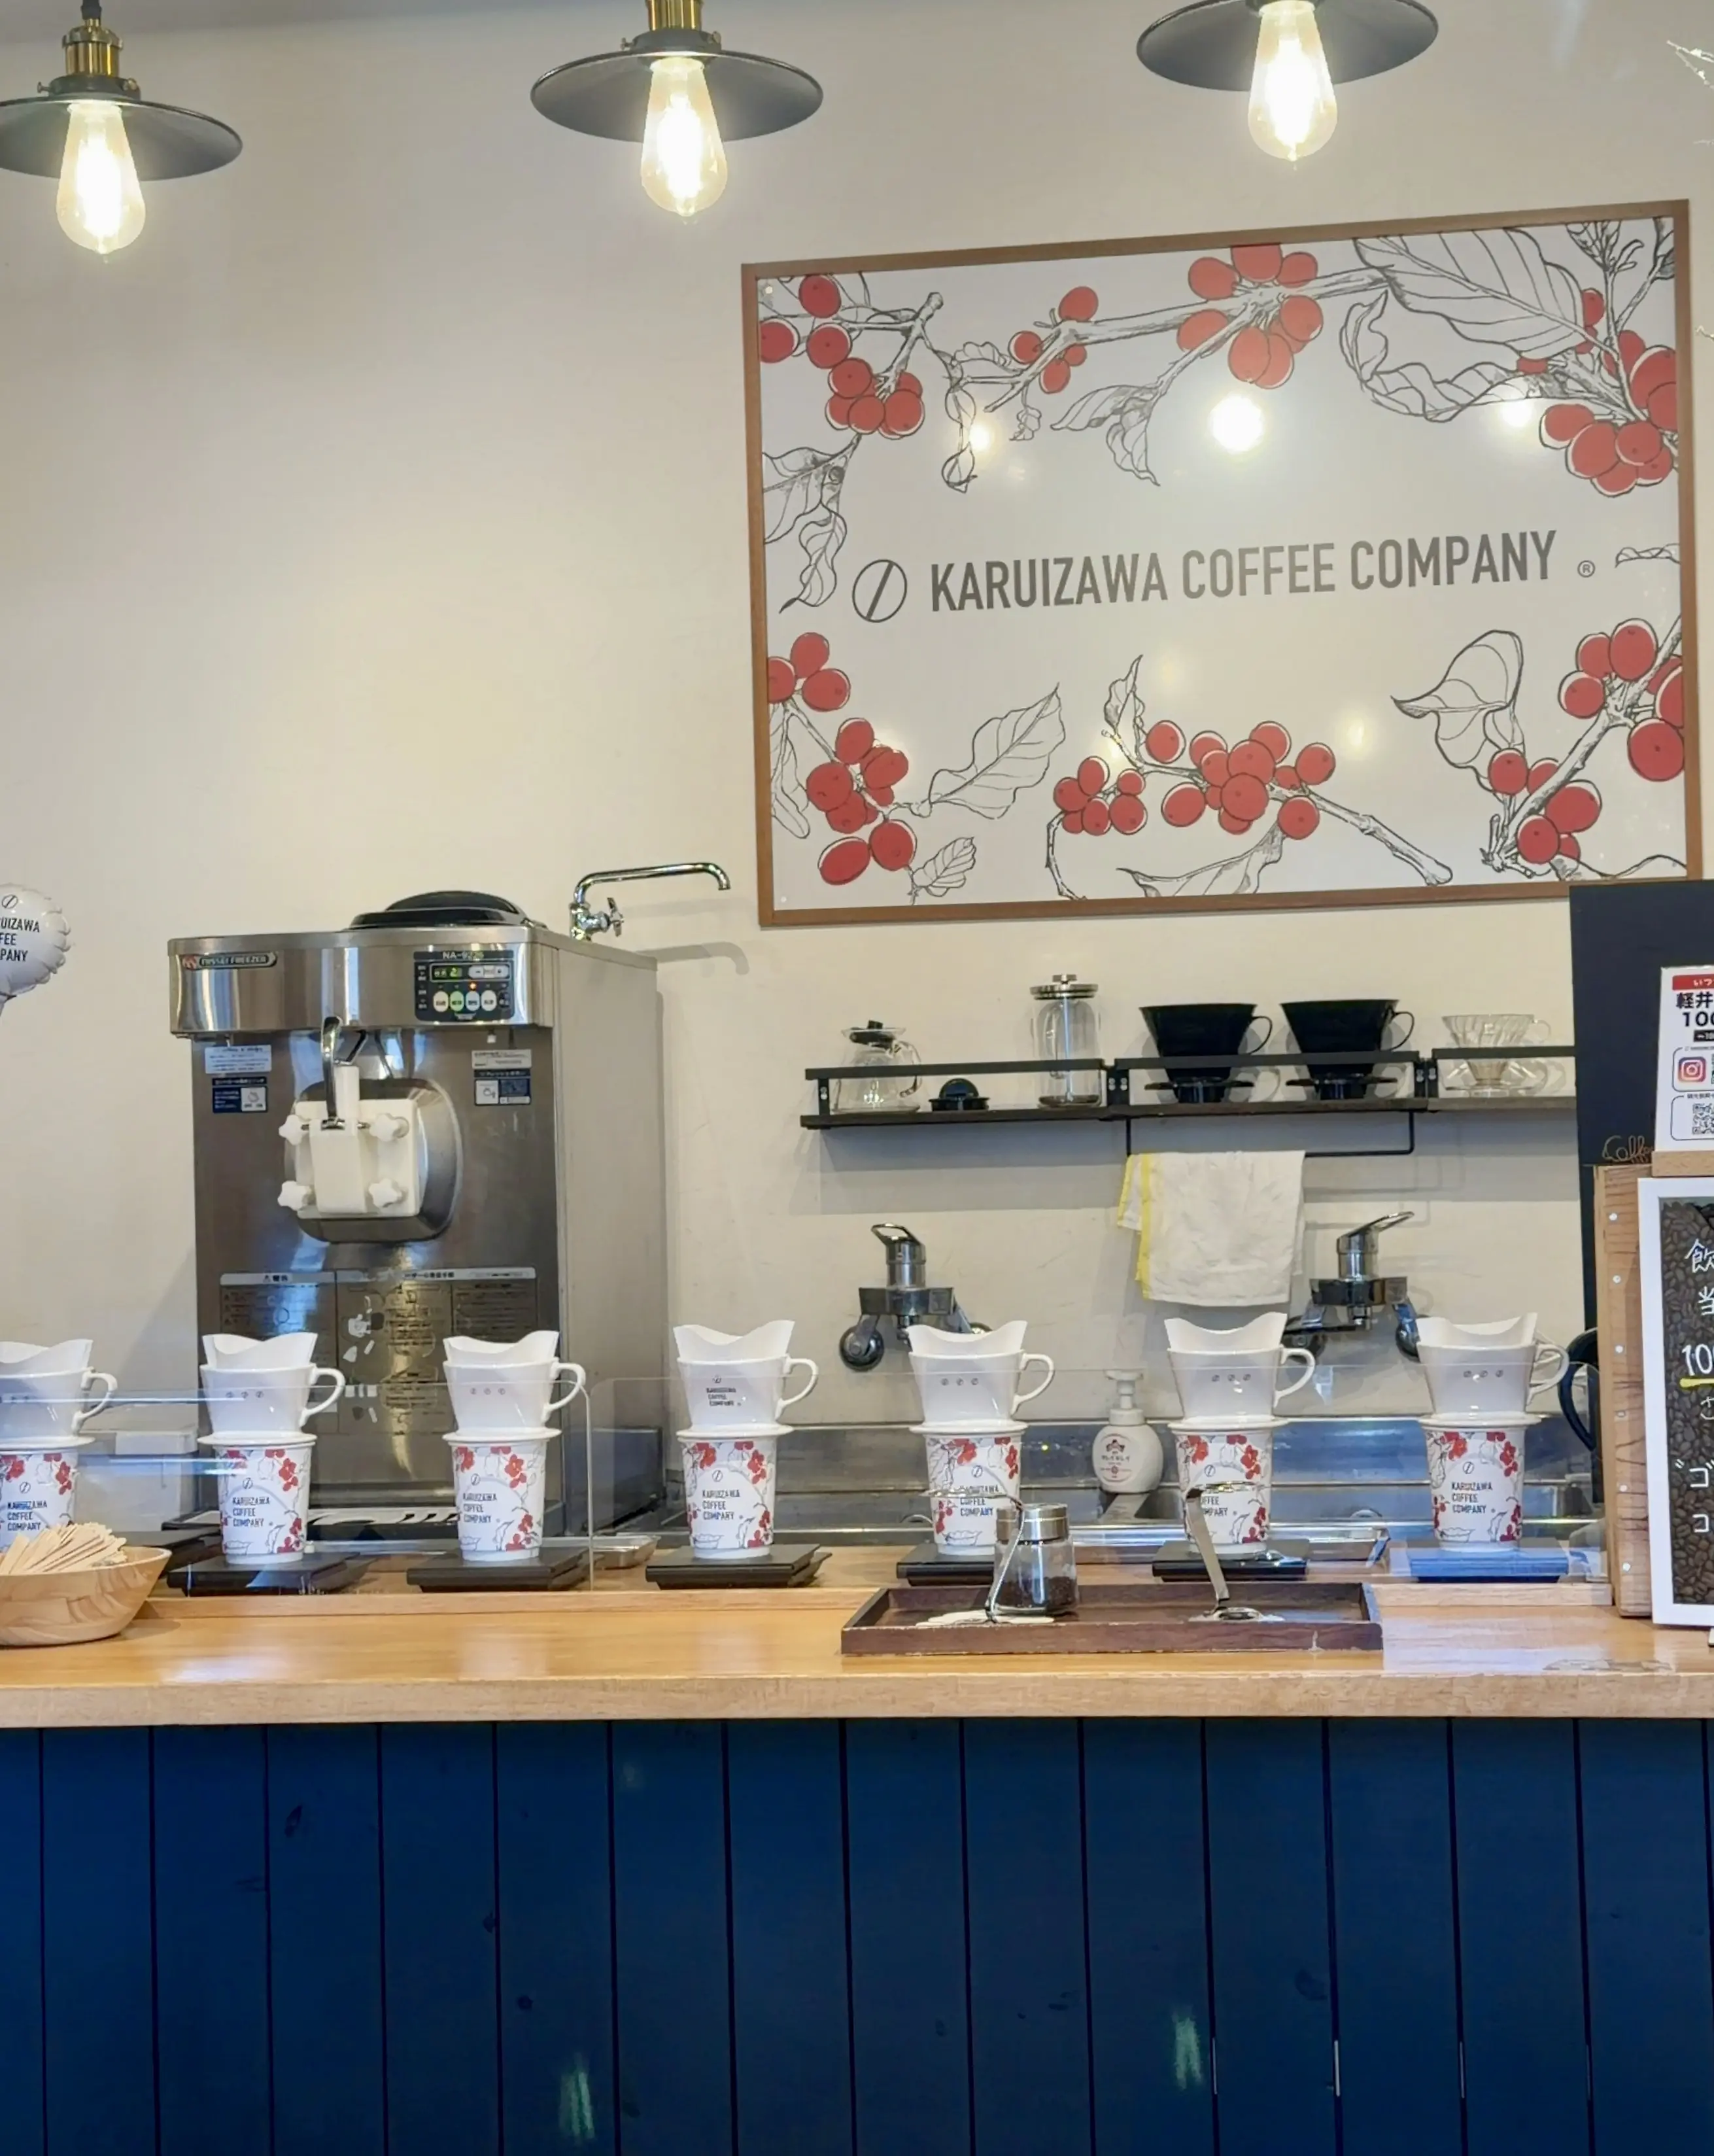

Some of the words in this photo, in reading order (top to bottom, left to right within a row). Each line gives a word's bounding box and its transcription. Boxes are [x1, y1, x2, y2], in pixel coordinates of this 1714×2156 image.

[931, 553, 1167, 612] KARUIZAWA
[1182, 543, 1335, 598] COFFEE
[1350, 530, 1556, 590] COMPANY
[0, 917, 40, 933] UIZAWA
[1693, 978, 1714, 986] いつ
[1676, 992, 1713, 1009] 軽井
[1682, 1344, 1714, 1376] 10
